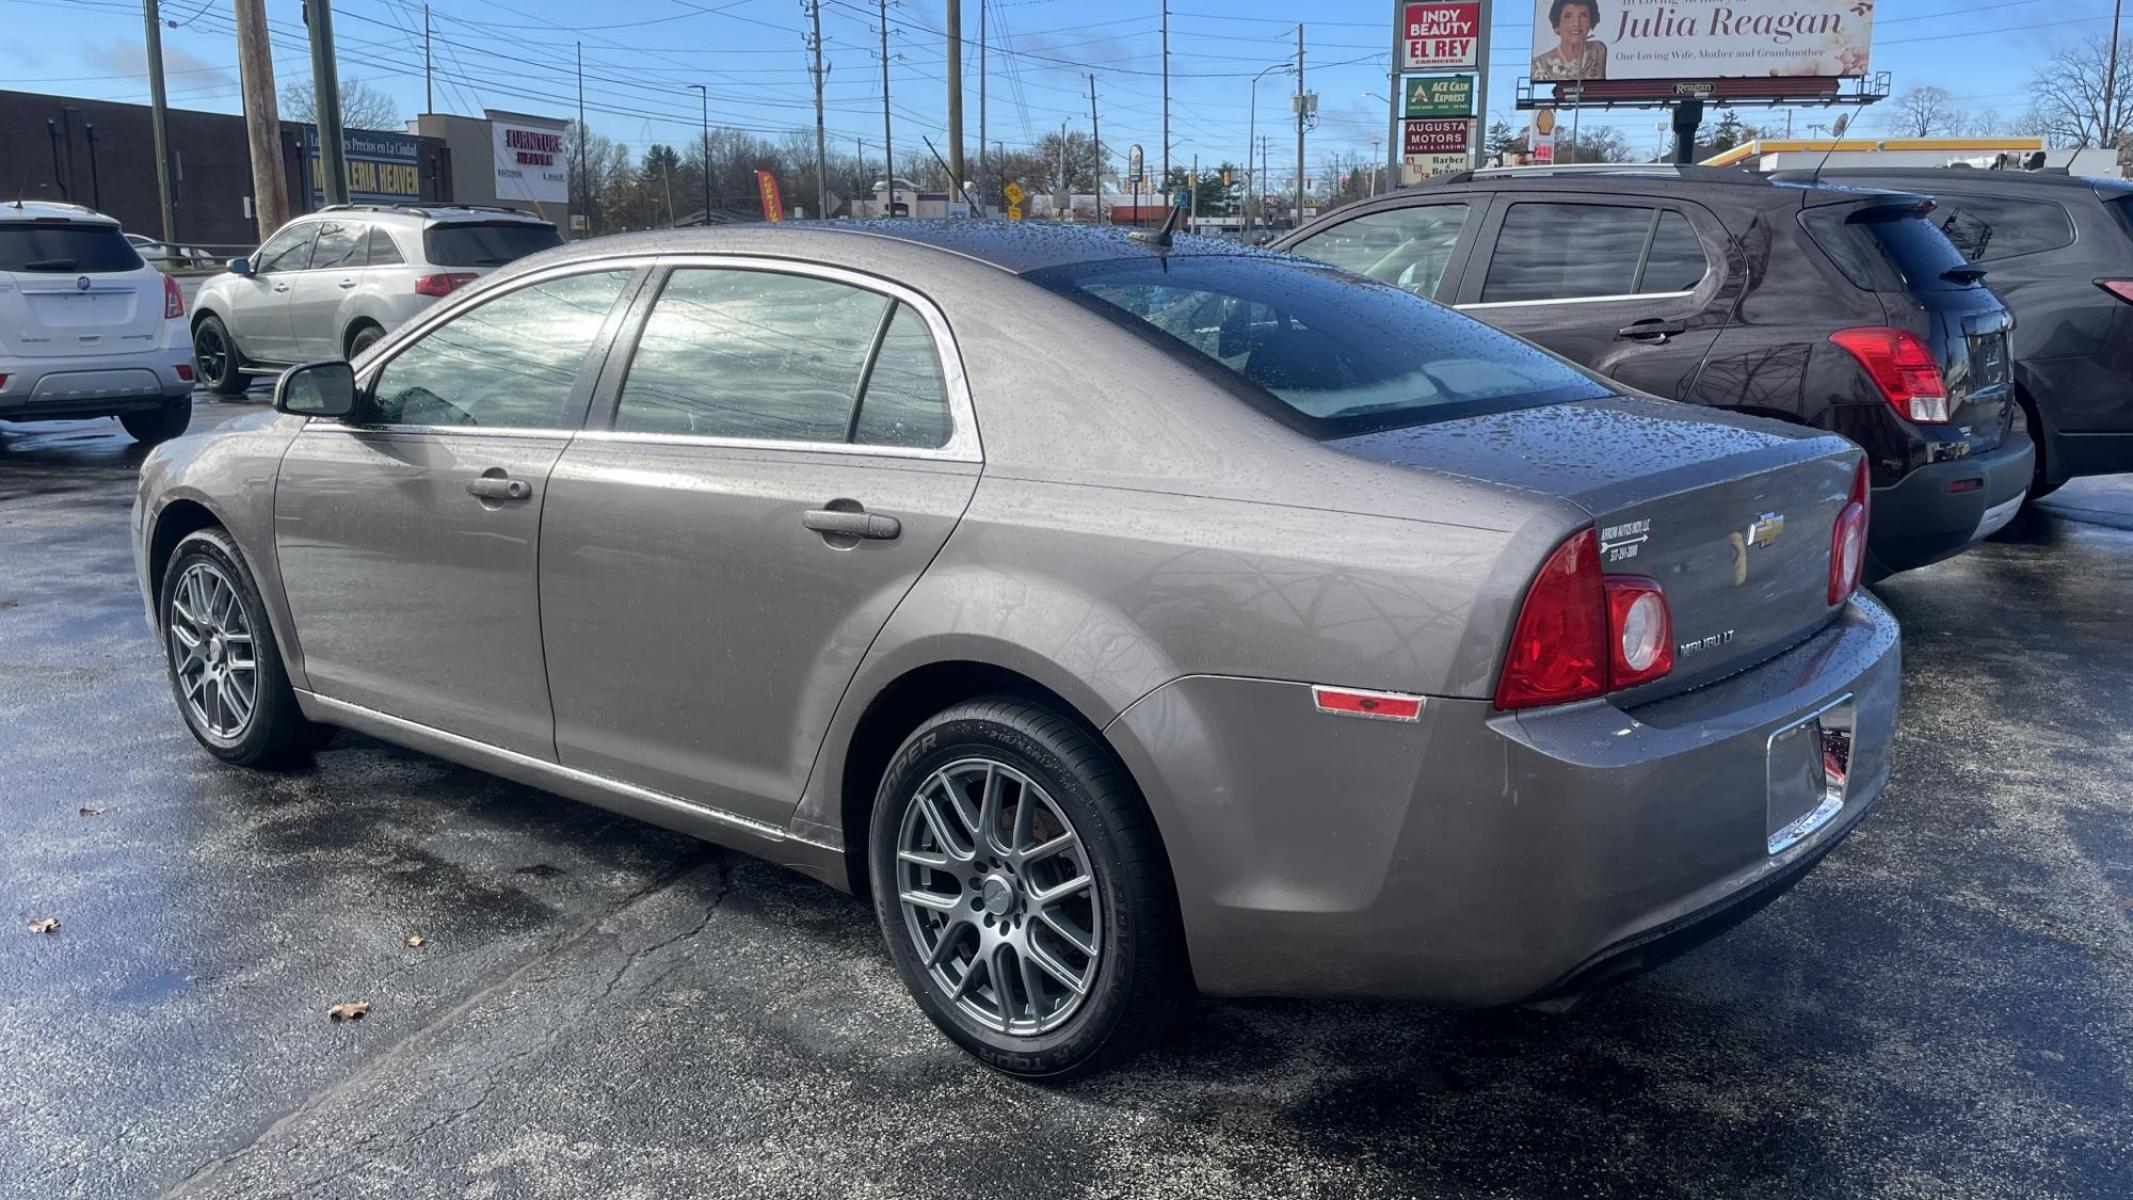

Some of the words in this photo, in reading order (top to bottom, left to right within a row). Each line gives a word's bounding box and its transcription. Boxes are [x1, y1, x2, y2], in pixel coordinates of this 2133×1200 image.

[1423, 9, 1460, 23] INDY
[1410, 21, 1472, 36] BEAUTY
[1611, 7, 1698, 44] Julia
[1707, 7, 1841, 44] Reagan
[1410, 41, 1429, 58] EL
[1435, 39, 1470, 57] REY
[1616, 51, 1635, 60] Our
[1637, 51, 1669, 61] Loving
[1672, 50, 1697, 60] Wife,
[1699, 48, 1734, 59] Mother
[1736, 49, 1754, 58] and
[1757, 47, 1825, 58] Grandmother
[1431, 81, 1448, 92] ACE
[1408, 122, 1466, 132] AUGUSTA
[506, 130, 563, 153] FURNITURE
[1411, 133, 1462, 144] MOTORS
[352, 138, 377, 152] Precios
[386, 142, 394, 154] La
[395, 142, 417, 157] Ciudad
[1432, 156, 1464, 164] Barber
[379, 163, 419, 194] HEAVEN
[1679, 633, 1720, 657] MALIBU
[1721, 629, 1734, 644] LT
